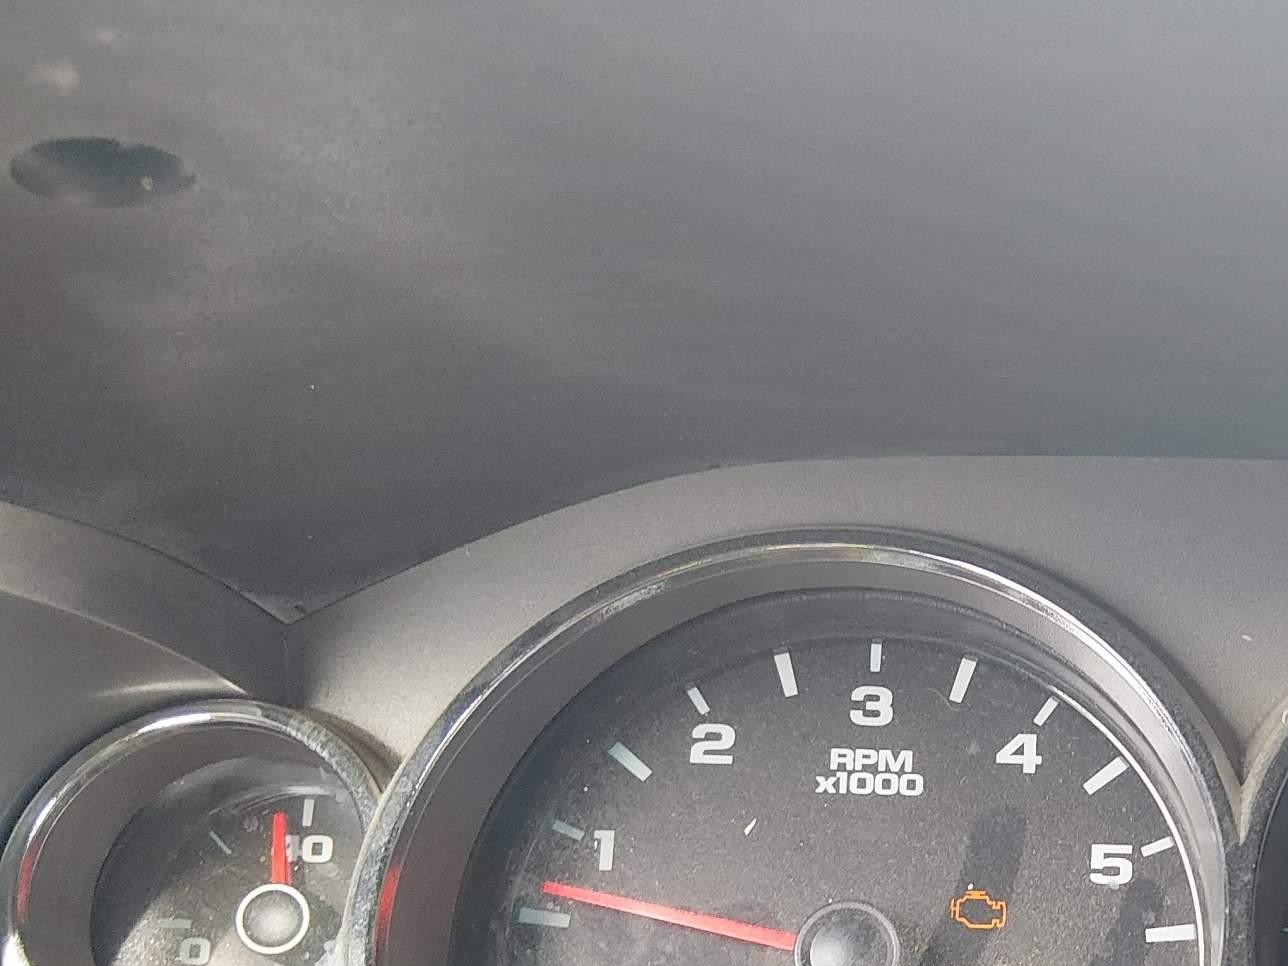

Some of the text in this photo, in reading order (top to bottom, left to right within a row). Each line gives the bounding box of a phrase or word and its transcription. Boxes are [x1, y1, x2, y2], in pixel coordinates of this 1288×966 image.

[849, 686, 894, 726] 3
[690, 724, 736, 764] 2
[829, 749, 913, 772] RPM
[996, 733, 1042, 773] 4
[815, 774, 924, 797] x1000
[594, 830, 615, 870] 1
[1089, 844, 1133, 884] 5
[179, 938, 210, 963] 0
